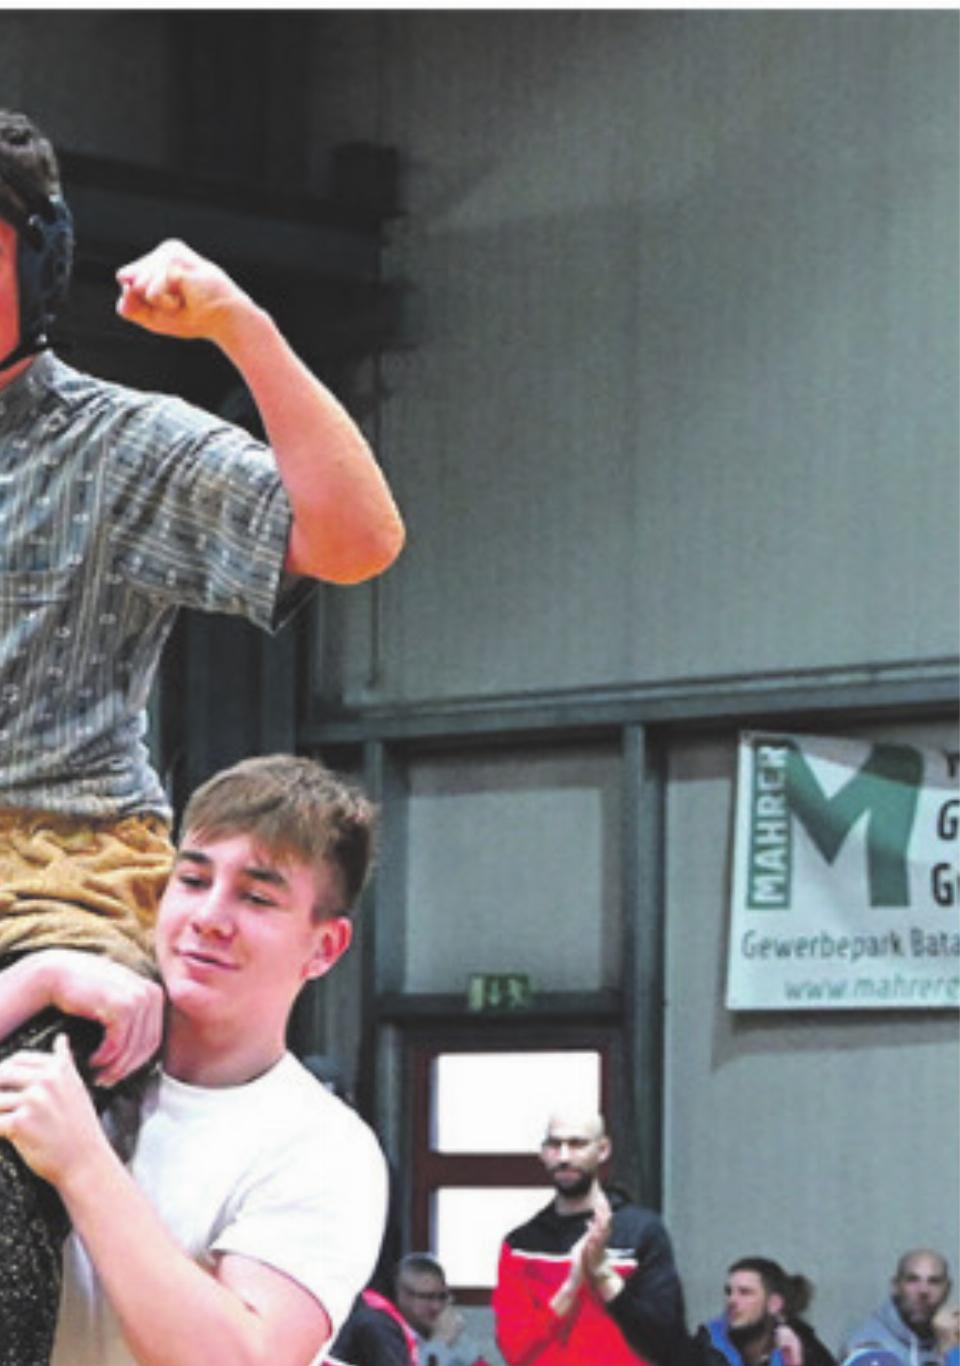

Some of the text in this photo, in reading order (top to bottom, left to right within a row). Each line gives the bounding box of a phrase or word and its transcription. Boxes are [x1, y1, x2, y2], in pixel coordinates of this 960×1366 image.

[752, 744, 788, 905] MAHRER
[742, 926, 960, 962] Gewerbepark Bata
